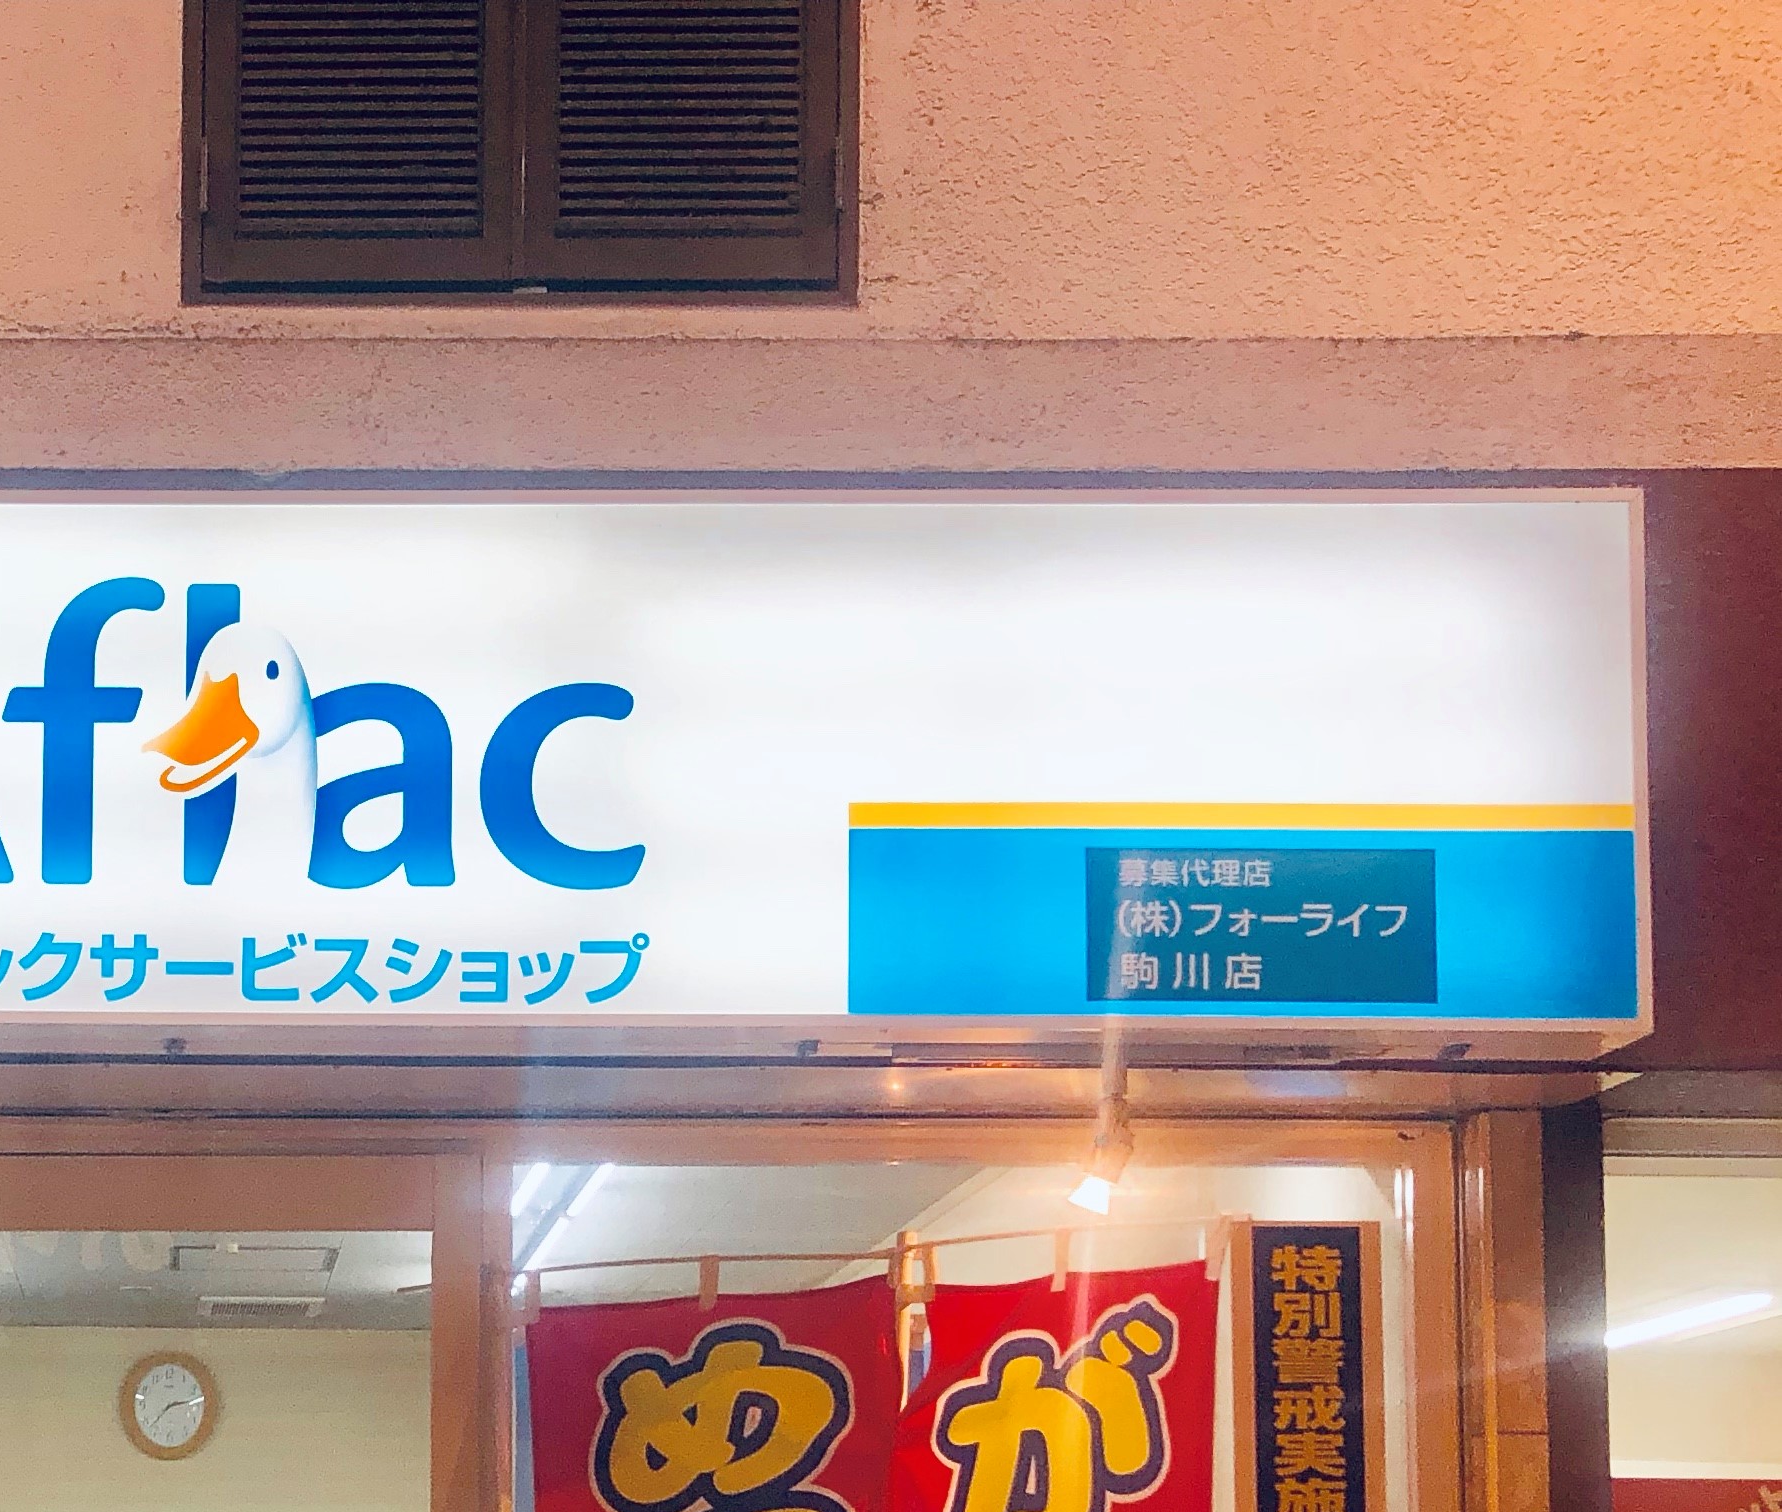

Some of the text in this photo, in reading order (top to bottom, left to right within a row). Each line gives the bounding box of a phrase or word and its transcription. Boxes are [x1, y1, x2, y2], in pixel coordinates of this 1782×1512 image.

[1118, 859, 1271, 888] 募集代理店
[1120, 952, 1262, 990] 駒川店
